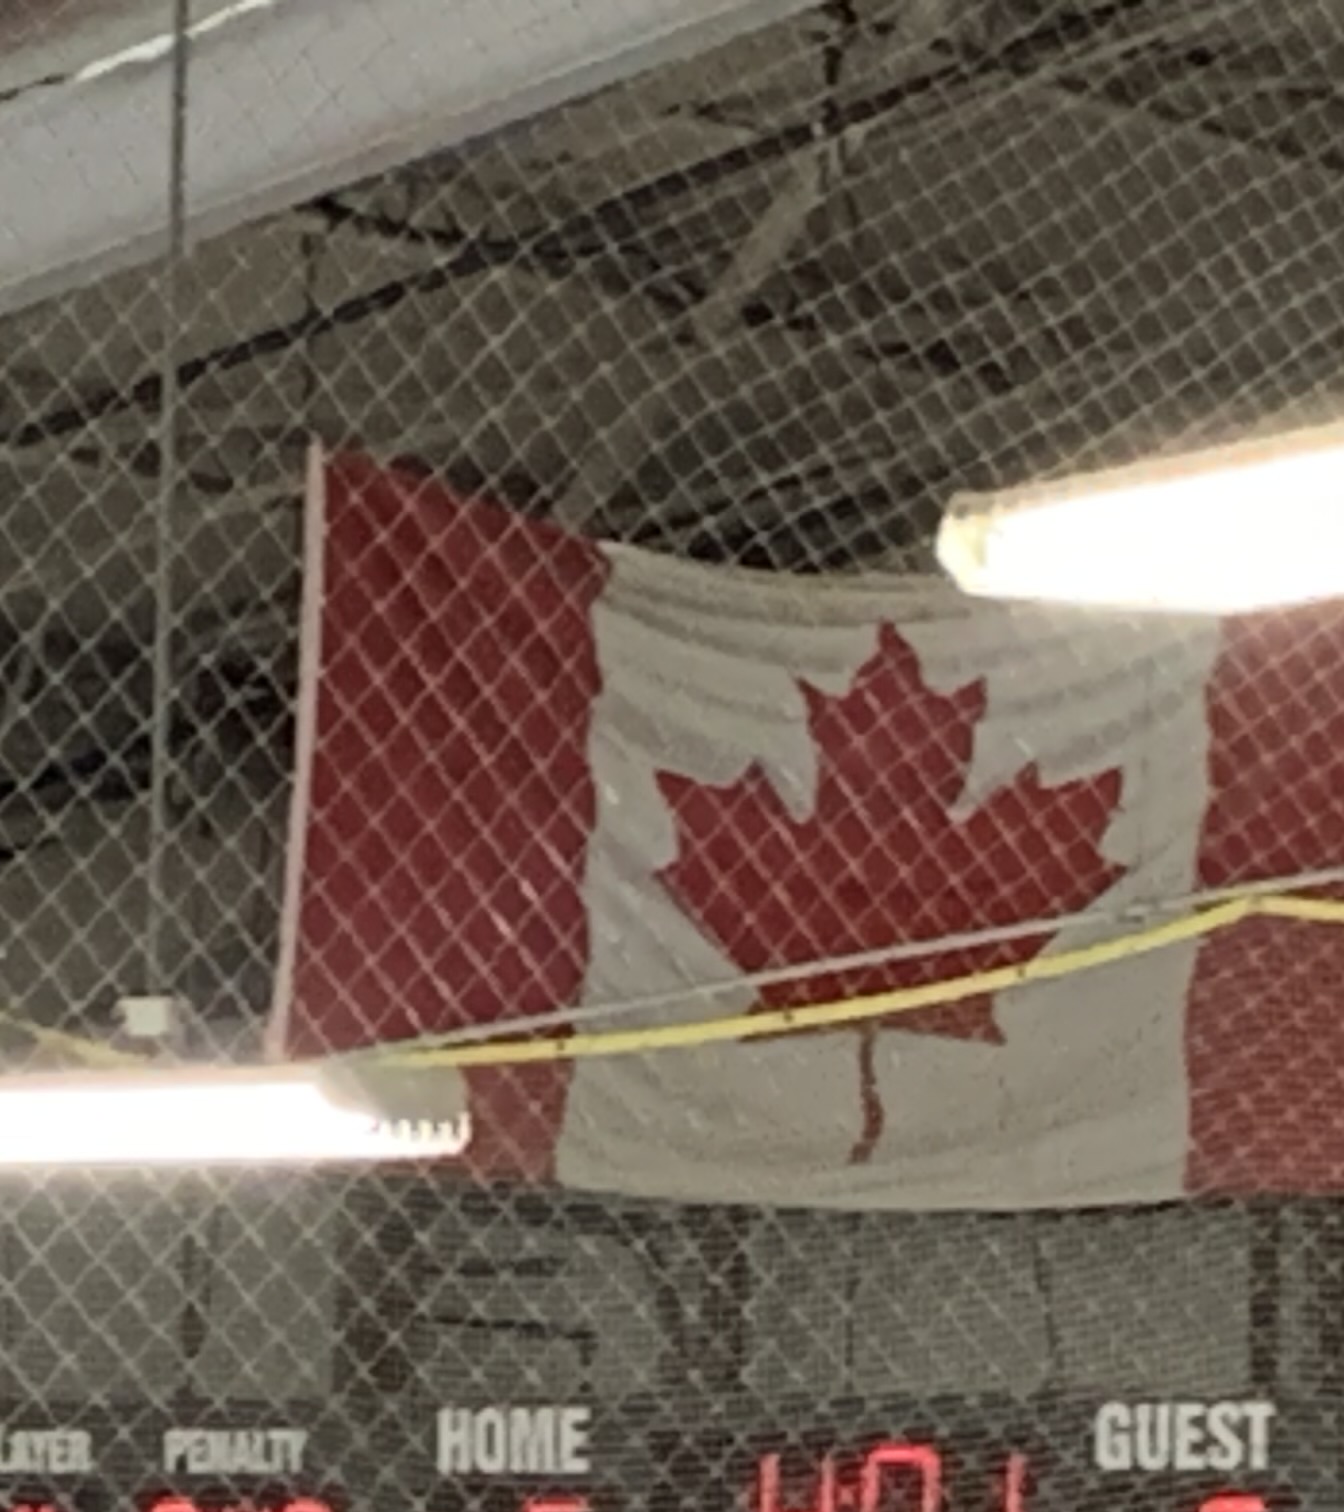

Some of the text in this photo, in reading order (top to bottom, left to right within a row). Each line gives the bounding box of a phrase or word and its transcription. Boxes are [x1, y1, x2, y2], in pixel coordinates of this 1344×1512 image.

[163, 1429, 308, 1475] PENALTY
[437, 1406, 590, 1475] HOME
[1094, 1401, 1277, 1472] GUEST
